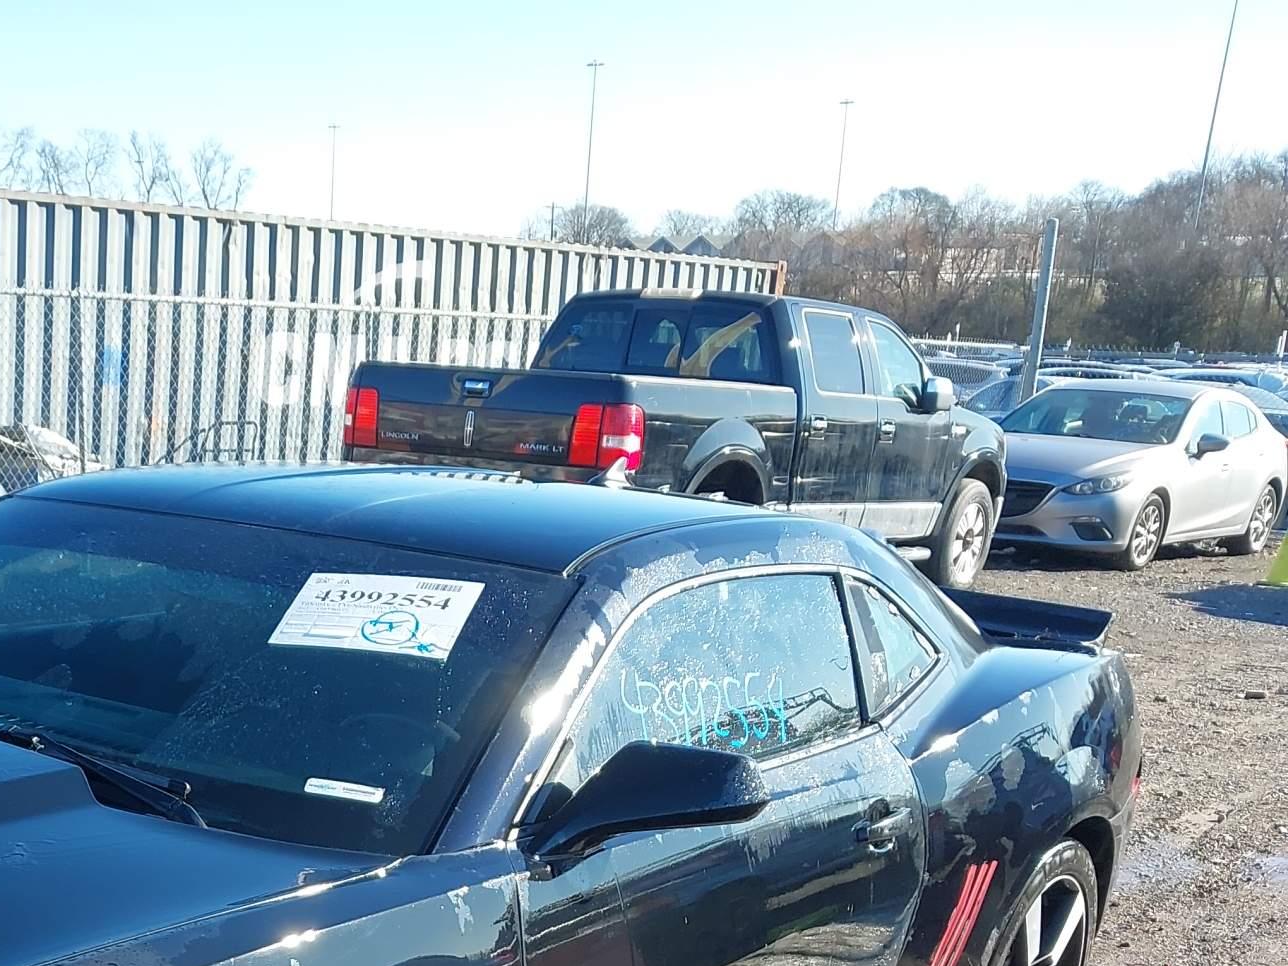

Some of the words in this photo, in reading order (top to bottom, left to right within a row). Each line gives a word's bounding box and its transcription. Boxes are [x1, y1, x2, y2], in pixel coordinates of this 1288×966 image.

[380, 430, 420, 442] LINCOLN
[519, 441, 550, 453] MARK
[552, 444, 565, 454] LT
[314, 588, 452, 611] 43992554
[620, 668, 788, 748] 43992554
